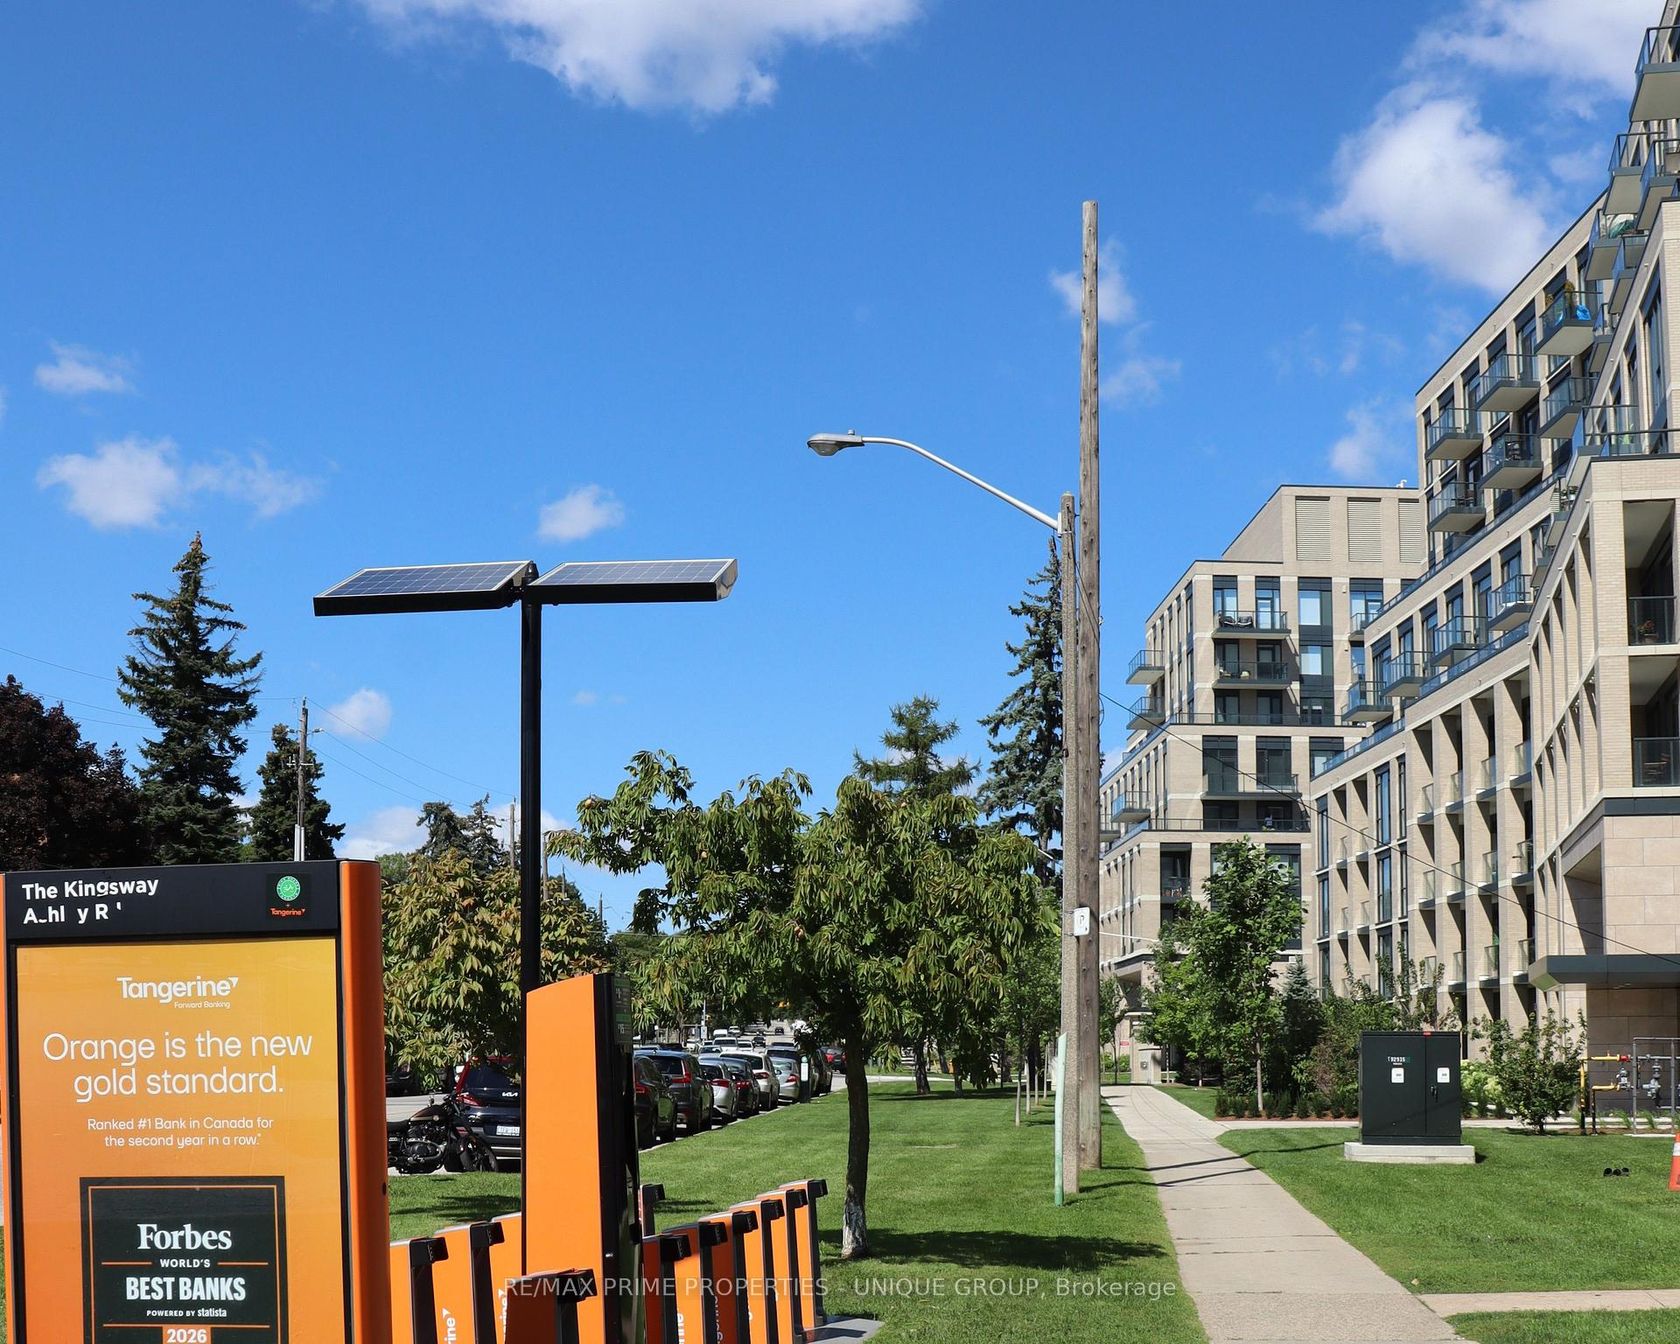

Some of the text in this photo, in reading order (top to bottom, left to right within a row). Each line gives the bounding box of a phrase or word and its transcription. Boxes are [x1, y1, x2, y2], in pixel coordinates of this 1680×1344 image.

[21, 879, 159, 900] The Kingsway
[23, 905, 89, 924] Ahly
[270, 907, 305, 917] Tangerine
[116, 975, 238, 1004] Tangerine
[203, 1000, 231, 1009] Banking
[43, 1030, 313, 1066] Orange is the new
[73, 1064, 284, 1103] gold standard.
[87, 1116, 274, 1131] Ranked #1 Bank in Canada for
[104, 1134, 124, 1147] the
[128, 1134, 174, 1147] second
[177, 1135, 205, 1149] year
[208, 1134, 219, 1146] in
[222, 1135, 231, 1146] a
[136, 1223, 233, 1250] Forbes
[159, 1258, 211, 1269] WORLD'S
[125, 1276, 247, 1301] BEST BANKS
[146, 1307, 227, 1317] POWERED BY statista
[166, 1328, 207, 1344] 2026
